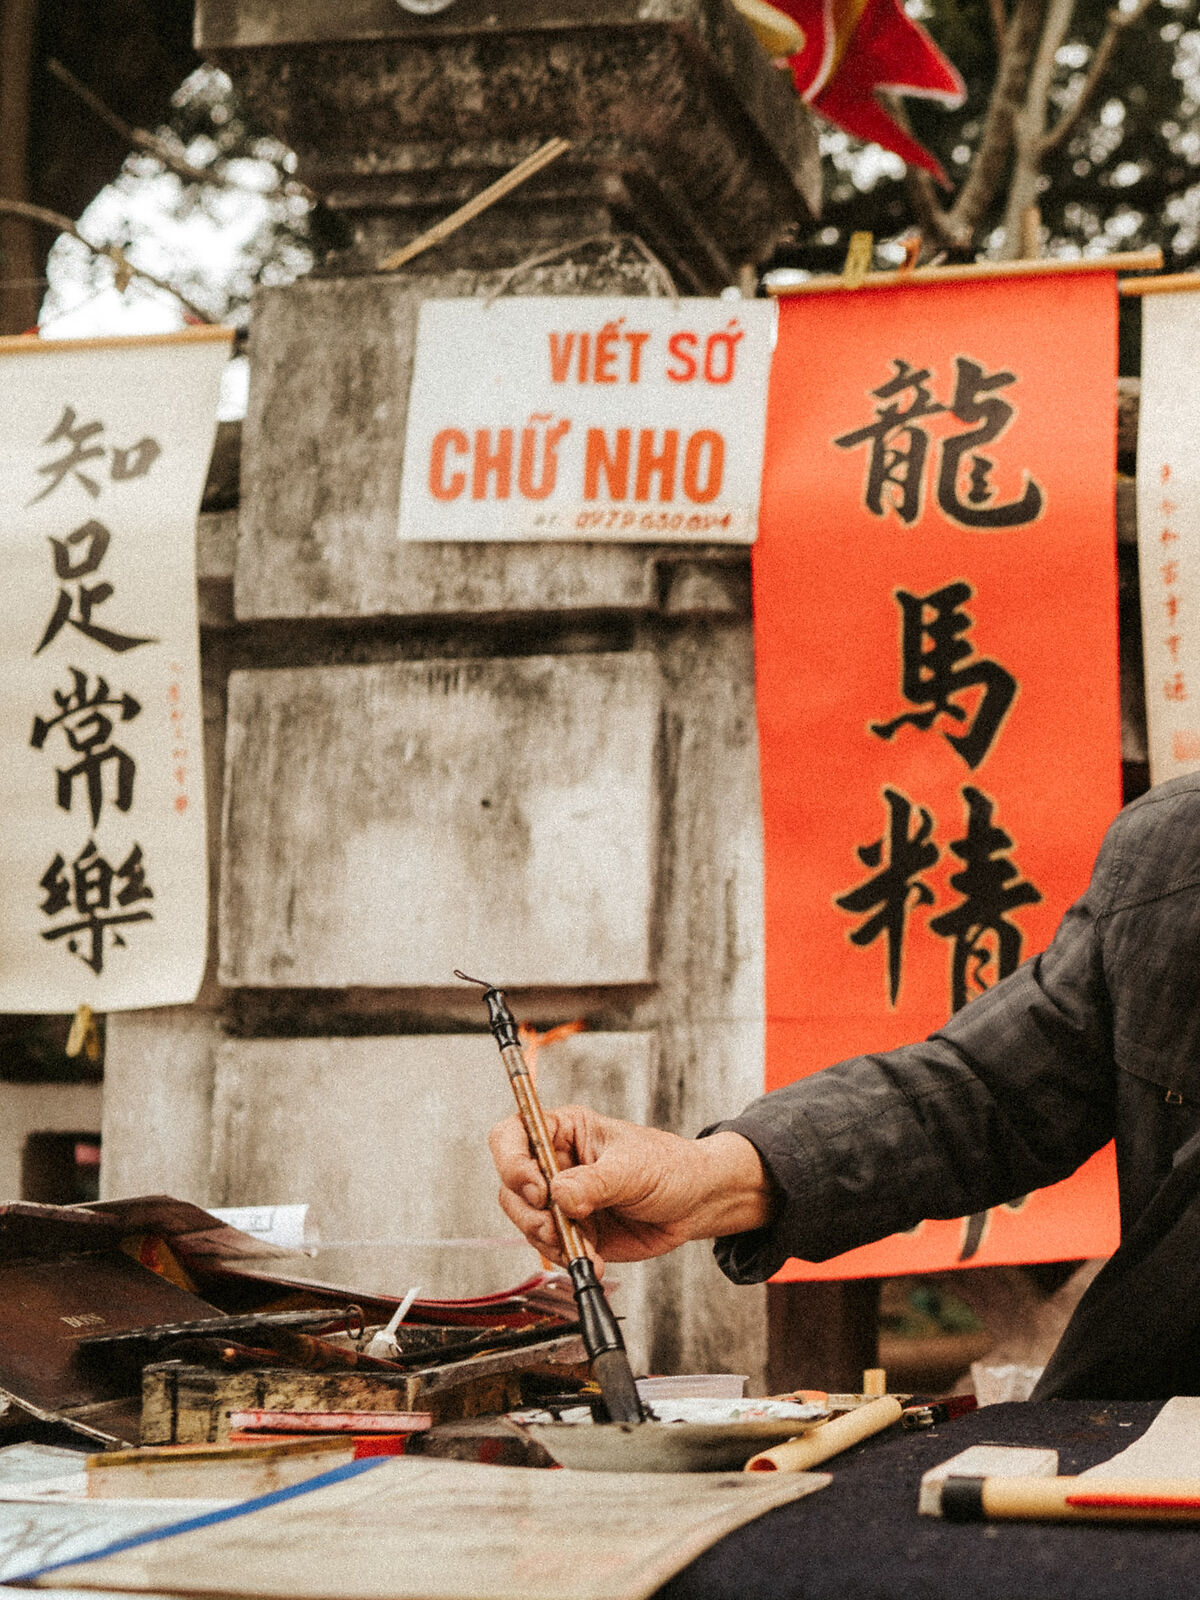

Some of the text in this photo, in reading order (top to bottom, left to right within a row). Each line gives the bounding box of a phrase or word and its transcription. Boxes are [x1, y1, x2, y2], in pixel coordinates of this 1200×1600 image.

[428, 412, 726, 504] CHỮ NHO
[549, 317, 745, 385] VIẾT SỚ
[24, 404, 162, 974] 知足常樂
[833, 356, 1044, 1262] 龍馬精
